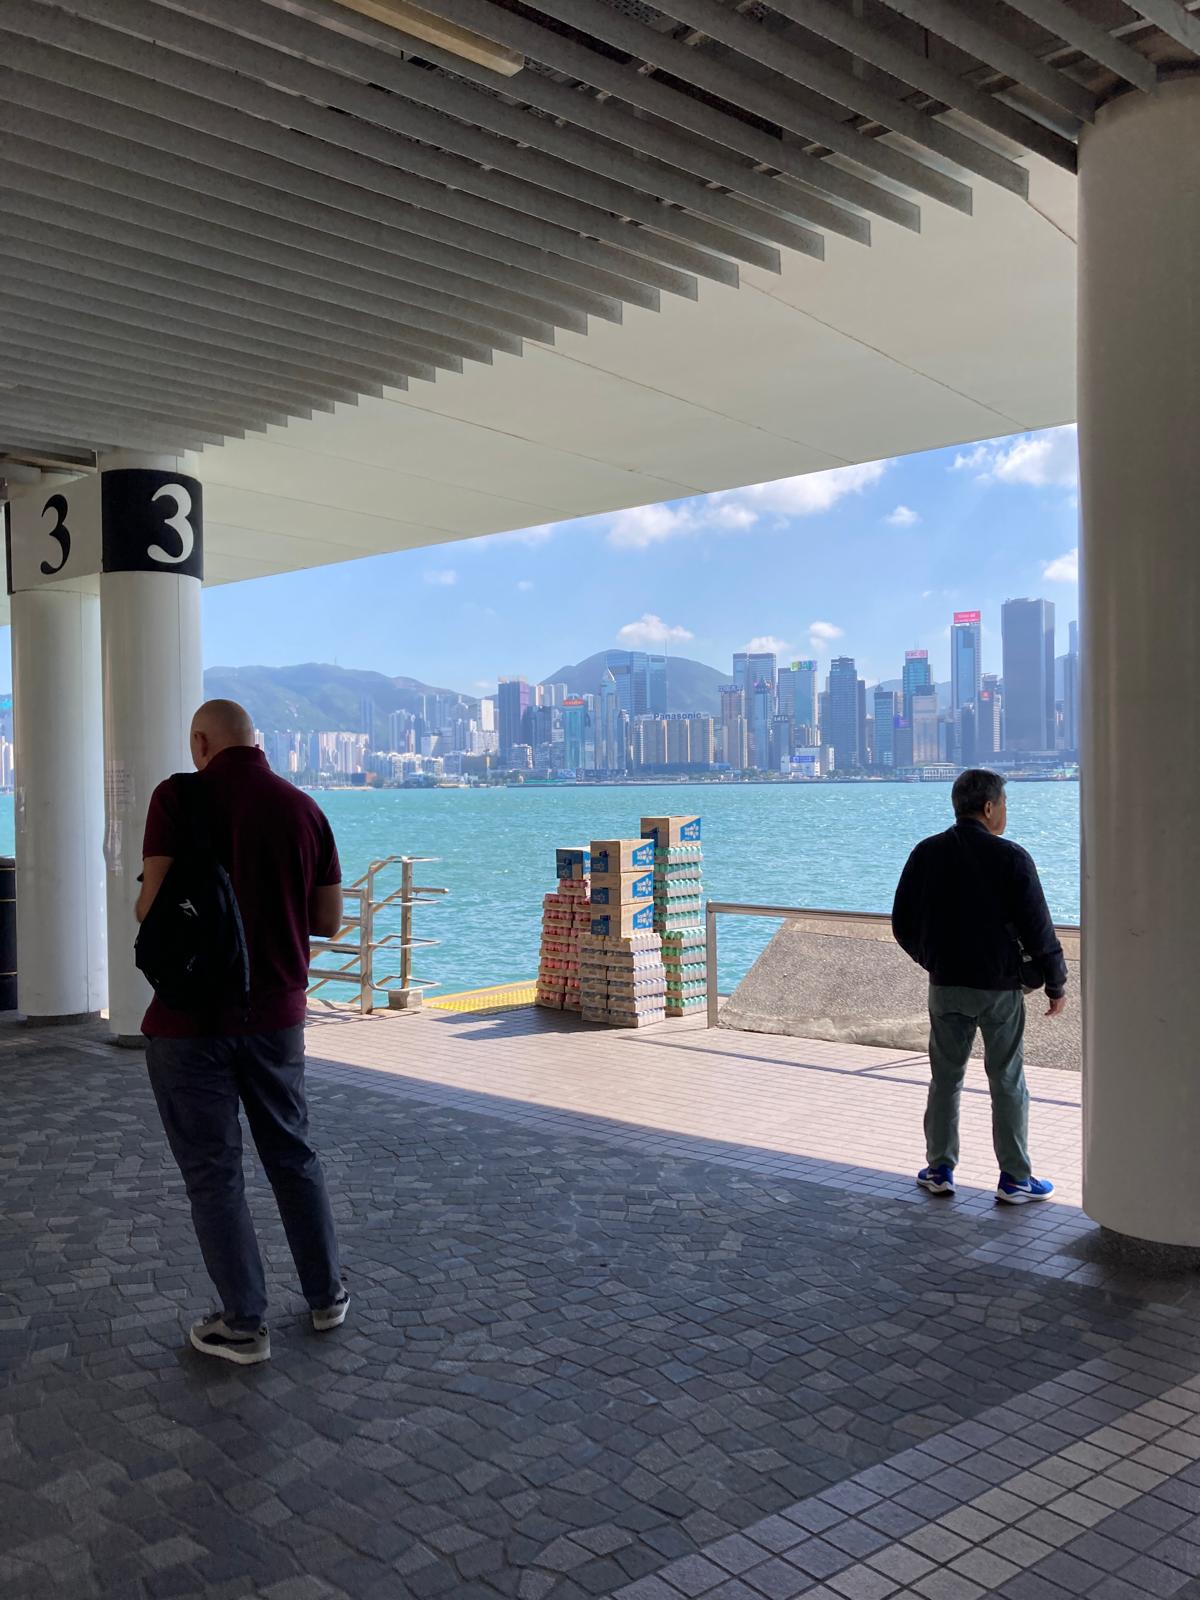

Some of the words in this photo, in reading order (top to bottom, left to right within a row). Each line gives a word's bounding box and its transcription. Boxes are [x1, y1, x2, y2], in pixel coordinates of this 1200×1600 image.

[40, 494, 71, 575] 3
[147, 483, 194, 562] 3
[653, 712, 702, 720] Panasonic
